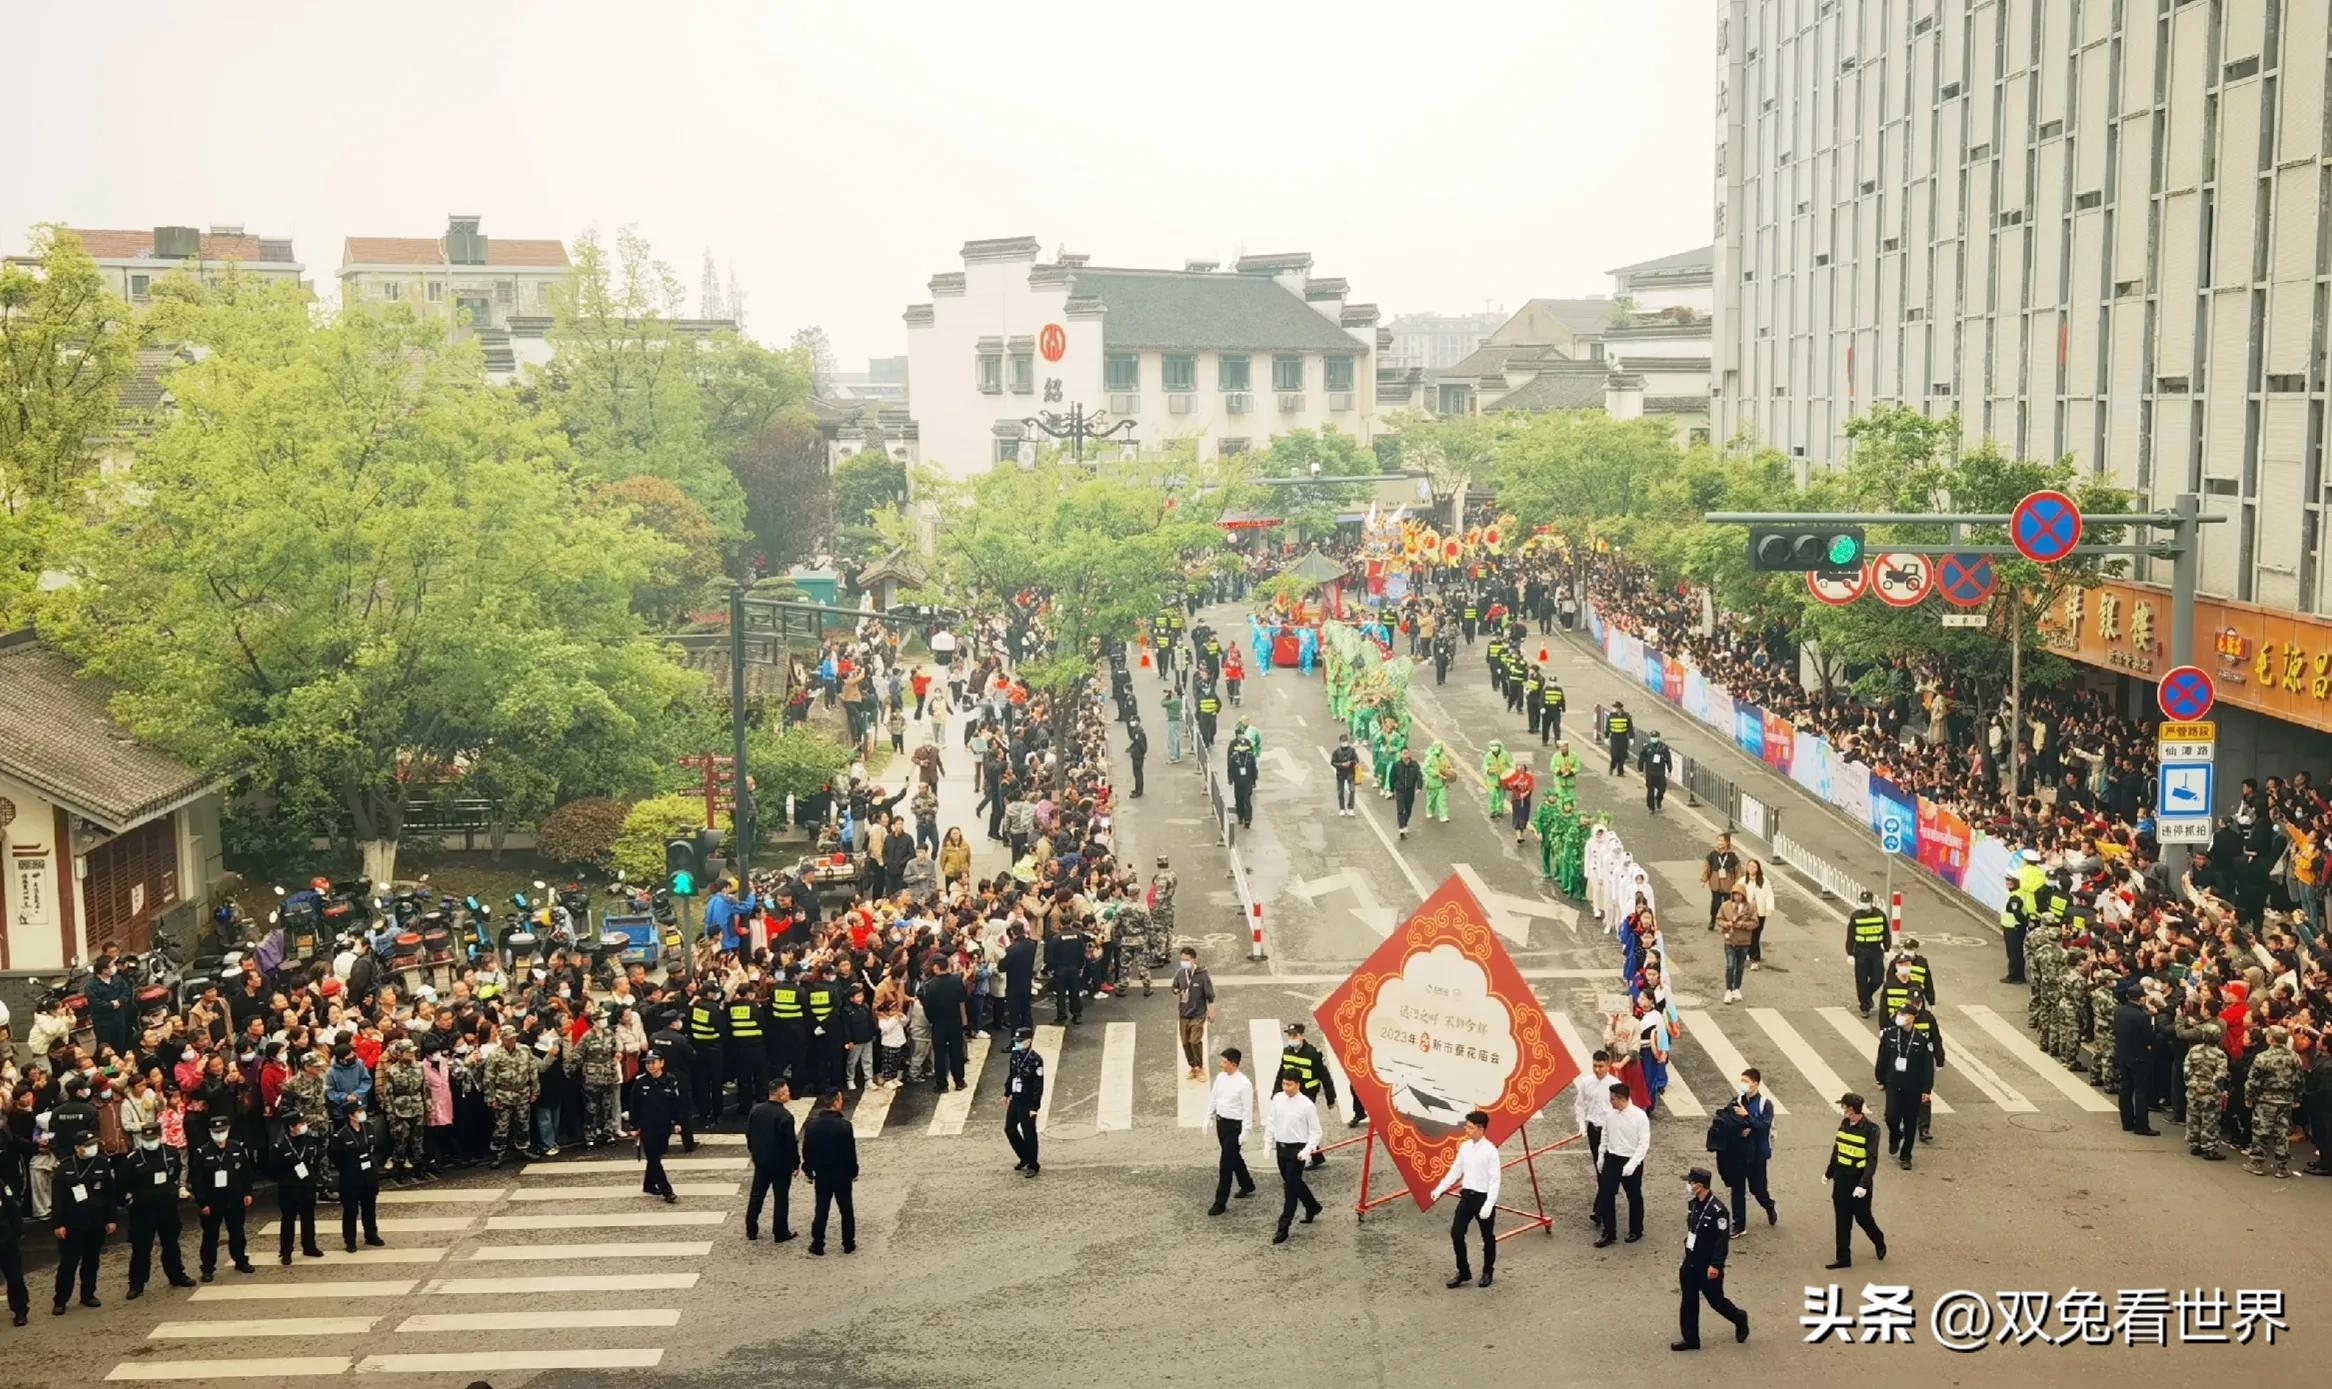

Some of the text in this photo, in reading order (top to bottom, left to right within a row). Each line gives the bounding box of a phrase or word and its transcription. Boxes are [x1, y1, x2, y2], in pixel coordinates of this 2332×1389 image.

[2164, 726, 2210, 738] 严管路段
[2165, 745, 2209, 757] 仙潭路
[2162, 825, 2207, 838] 违停抓拍
